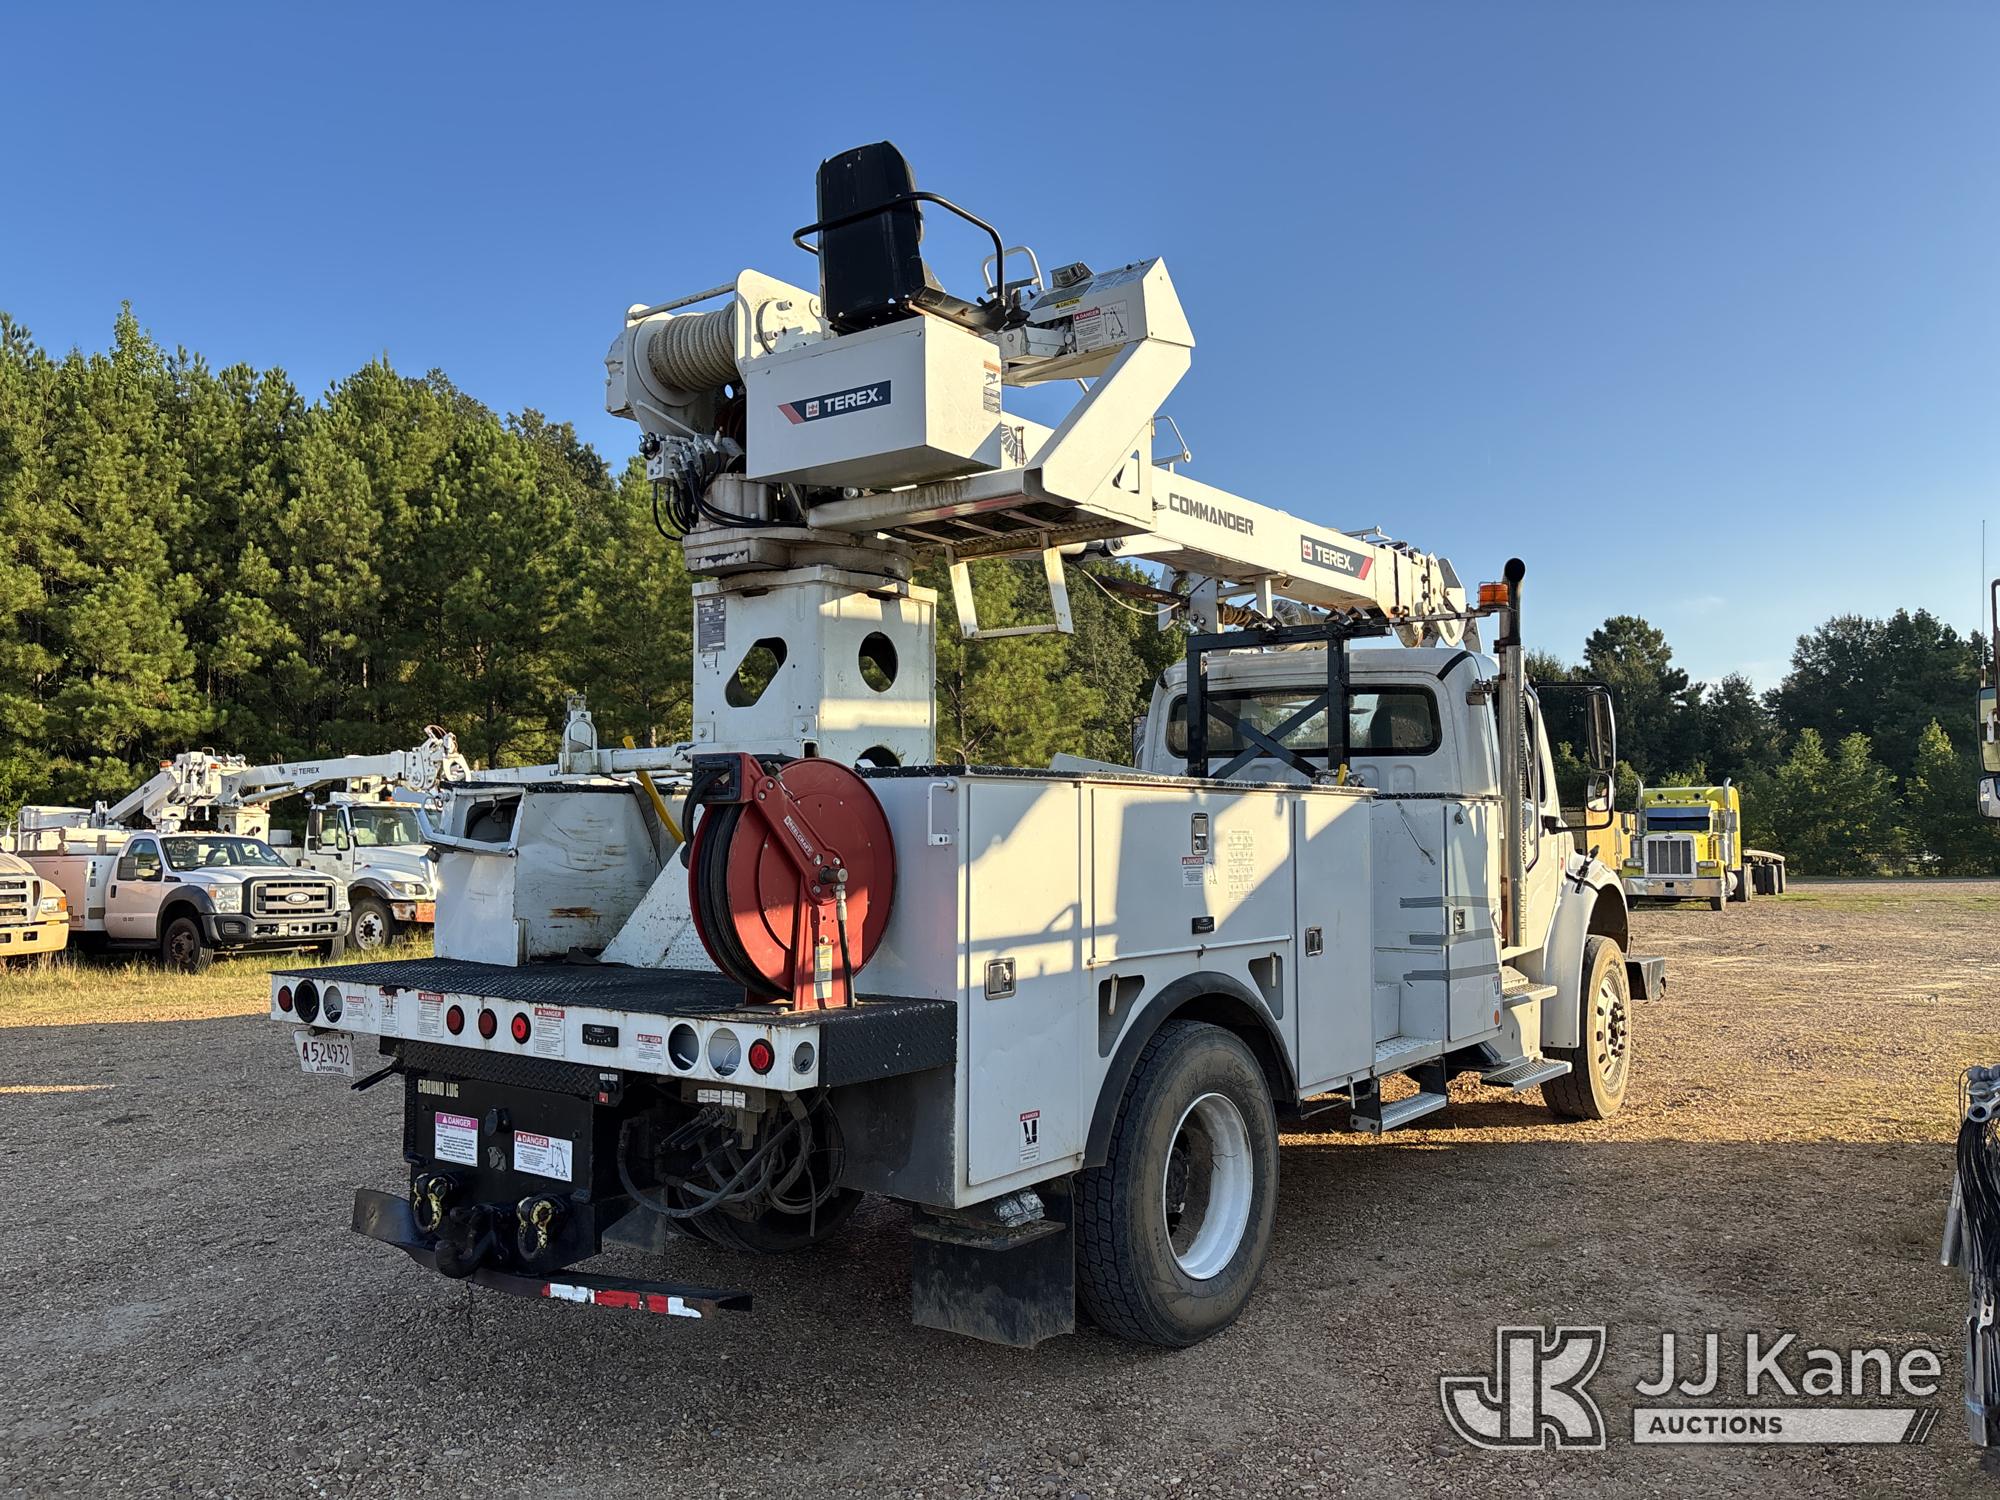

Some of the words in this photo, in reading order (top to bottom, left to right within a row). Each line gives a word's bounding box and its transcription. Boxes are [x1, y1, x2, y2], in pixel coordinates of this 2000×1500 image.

[1079, 310, 1099, 320] DANGER
[824, 388, 879, 412] TEREX
[1169, 492, 1254, 536] COMMANDER
[1315, 545, 1352, 571] TEREX
[299, 767, 320, 775] TEREX
[788, 821, 813, 855] REELCRAFT
[543, 1010, 562, 1018] DANGER
[418, 1079, 444, 1097] GROUND
[446, 1083, 459, 1098] LUG
[447, 1116, 472, 1128] DANGER
[522, 1135, 548, 1147] DANGER
